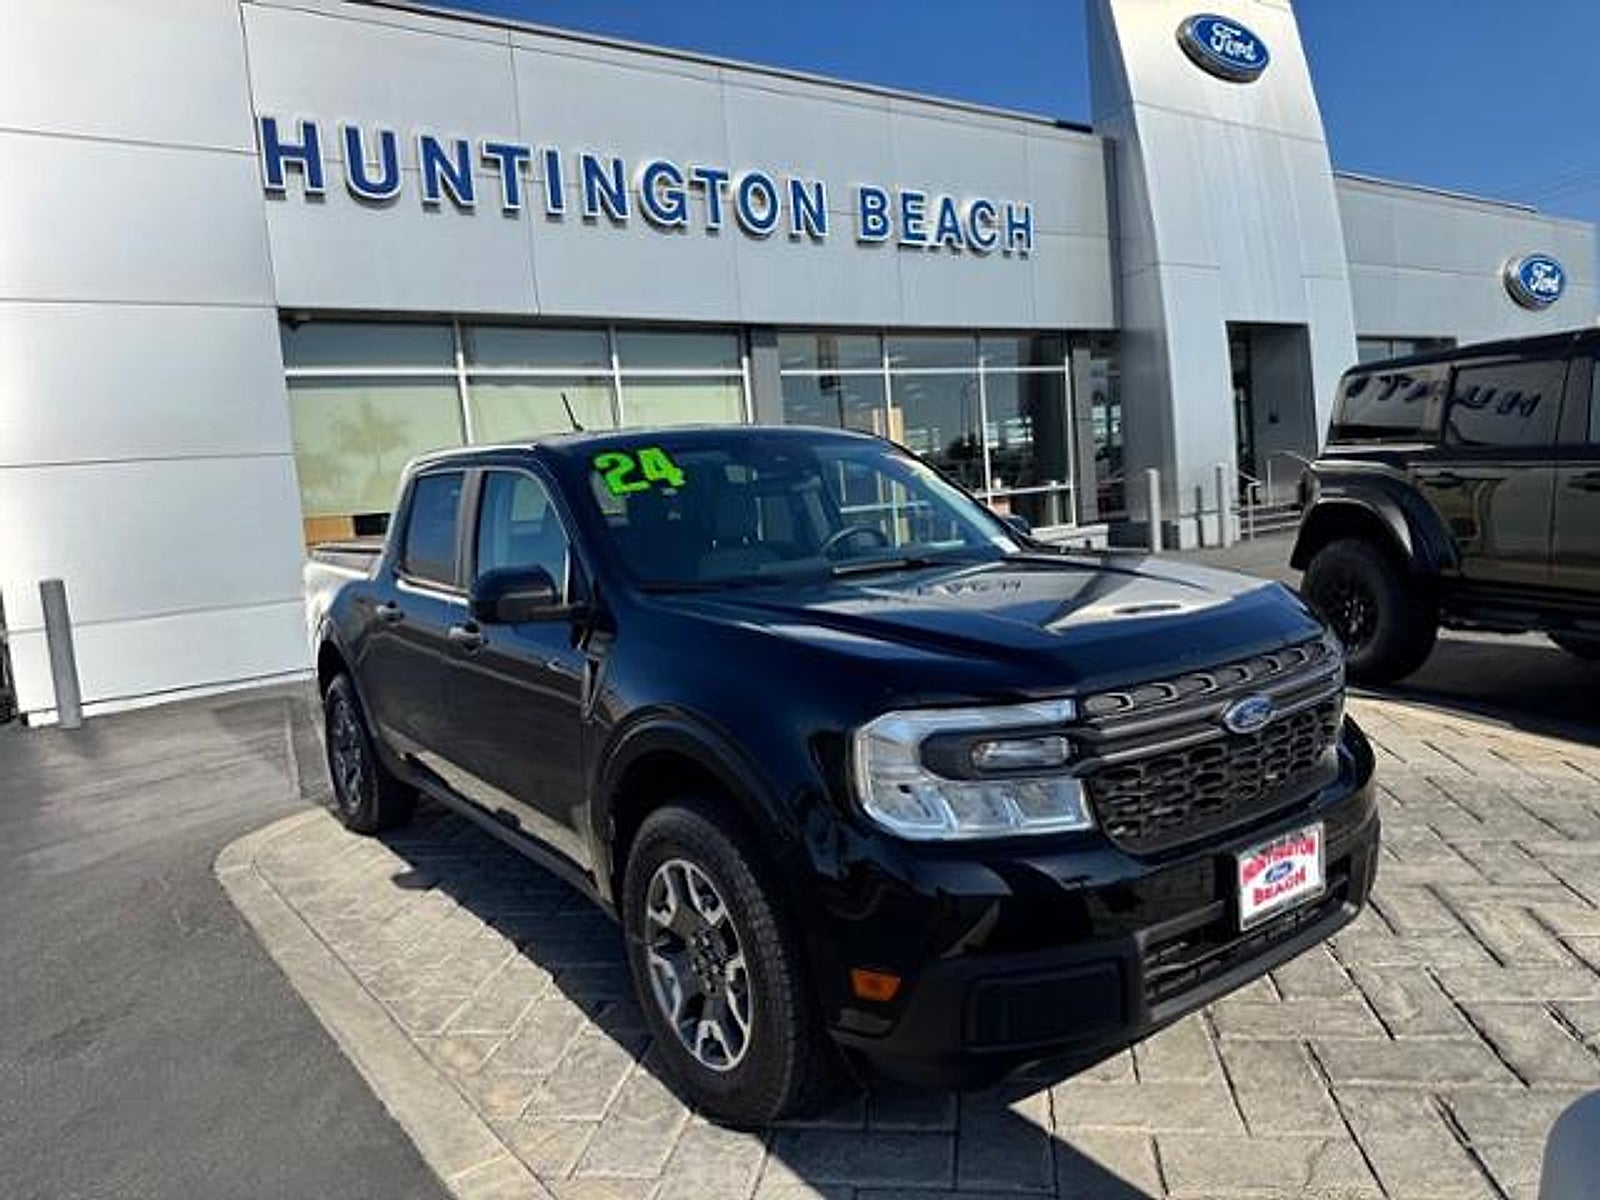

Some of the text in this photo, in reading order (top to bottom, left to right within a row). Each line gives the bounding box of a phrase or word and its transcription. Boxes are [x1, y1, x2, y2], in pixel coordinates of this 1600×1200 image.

[1210, 22, 1256, 61] Ford
[259, 115, 1034, 254] HUNTINGTON BEACH
[1529, 262, 1559, 292] Ford
[594, 447, 686, 493] 24
[1253, 866, 1307, 907] BEACH
